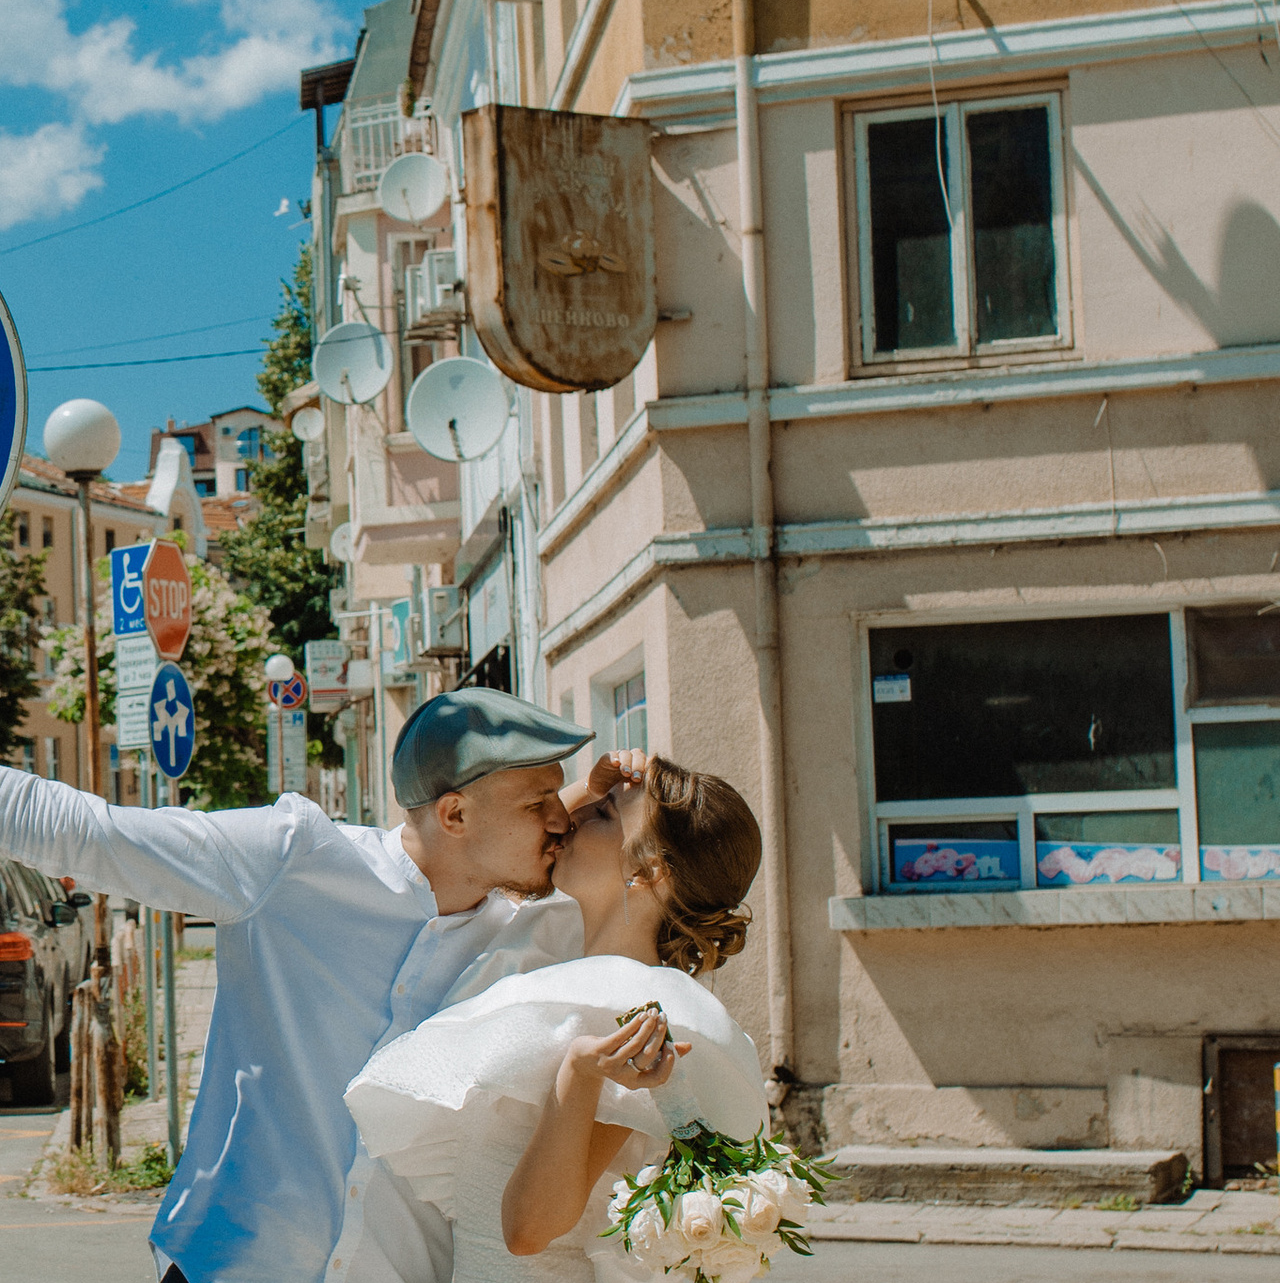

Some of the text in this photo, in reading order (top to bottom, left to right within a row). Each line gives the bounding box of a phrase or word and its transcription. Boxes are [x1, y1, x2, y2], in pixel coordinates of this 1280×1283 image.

[149, 578, 188, 620] STOP
[119, 617, 145, 631] 2 мес
